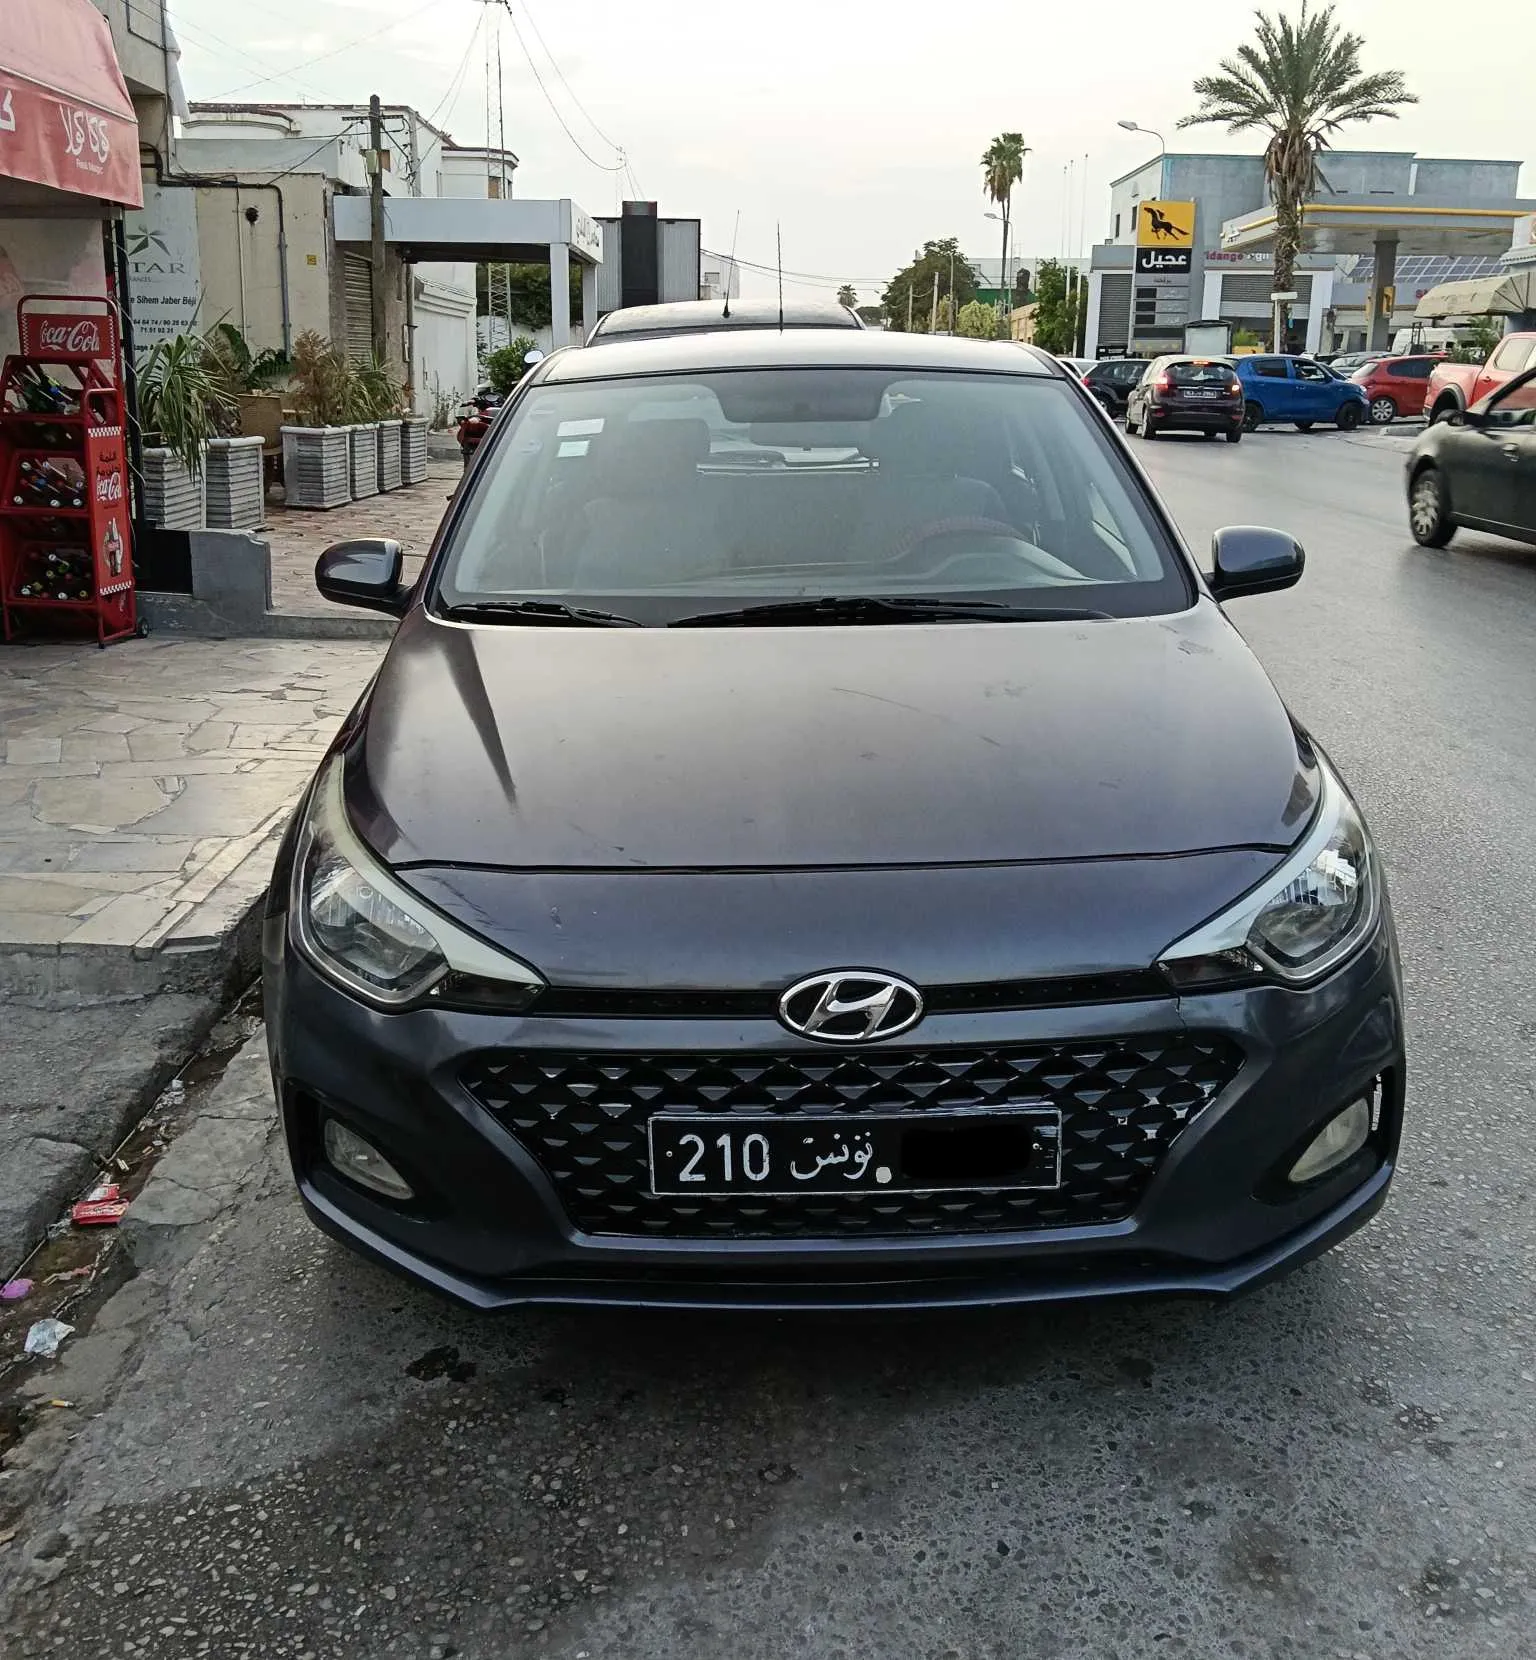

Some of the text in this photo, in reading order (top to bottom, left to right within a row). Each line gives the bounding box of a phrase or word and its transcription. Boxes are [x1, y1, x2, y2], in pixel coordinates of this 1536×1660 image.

[1141, 250, 1188, 269] عجيل
[129, 262, 185, 274] TAR
[136, 295, 159, 305] Sihem
[160, 295, 181, 305] Jaber
[678, 1131, 874, 1183] 210 تونس
